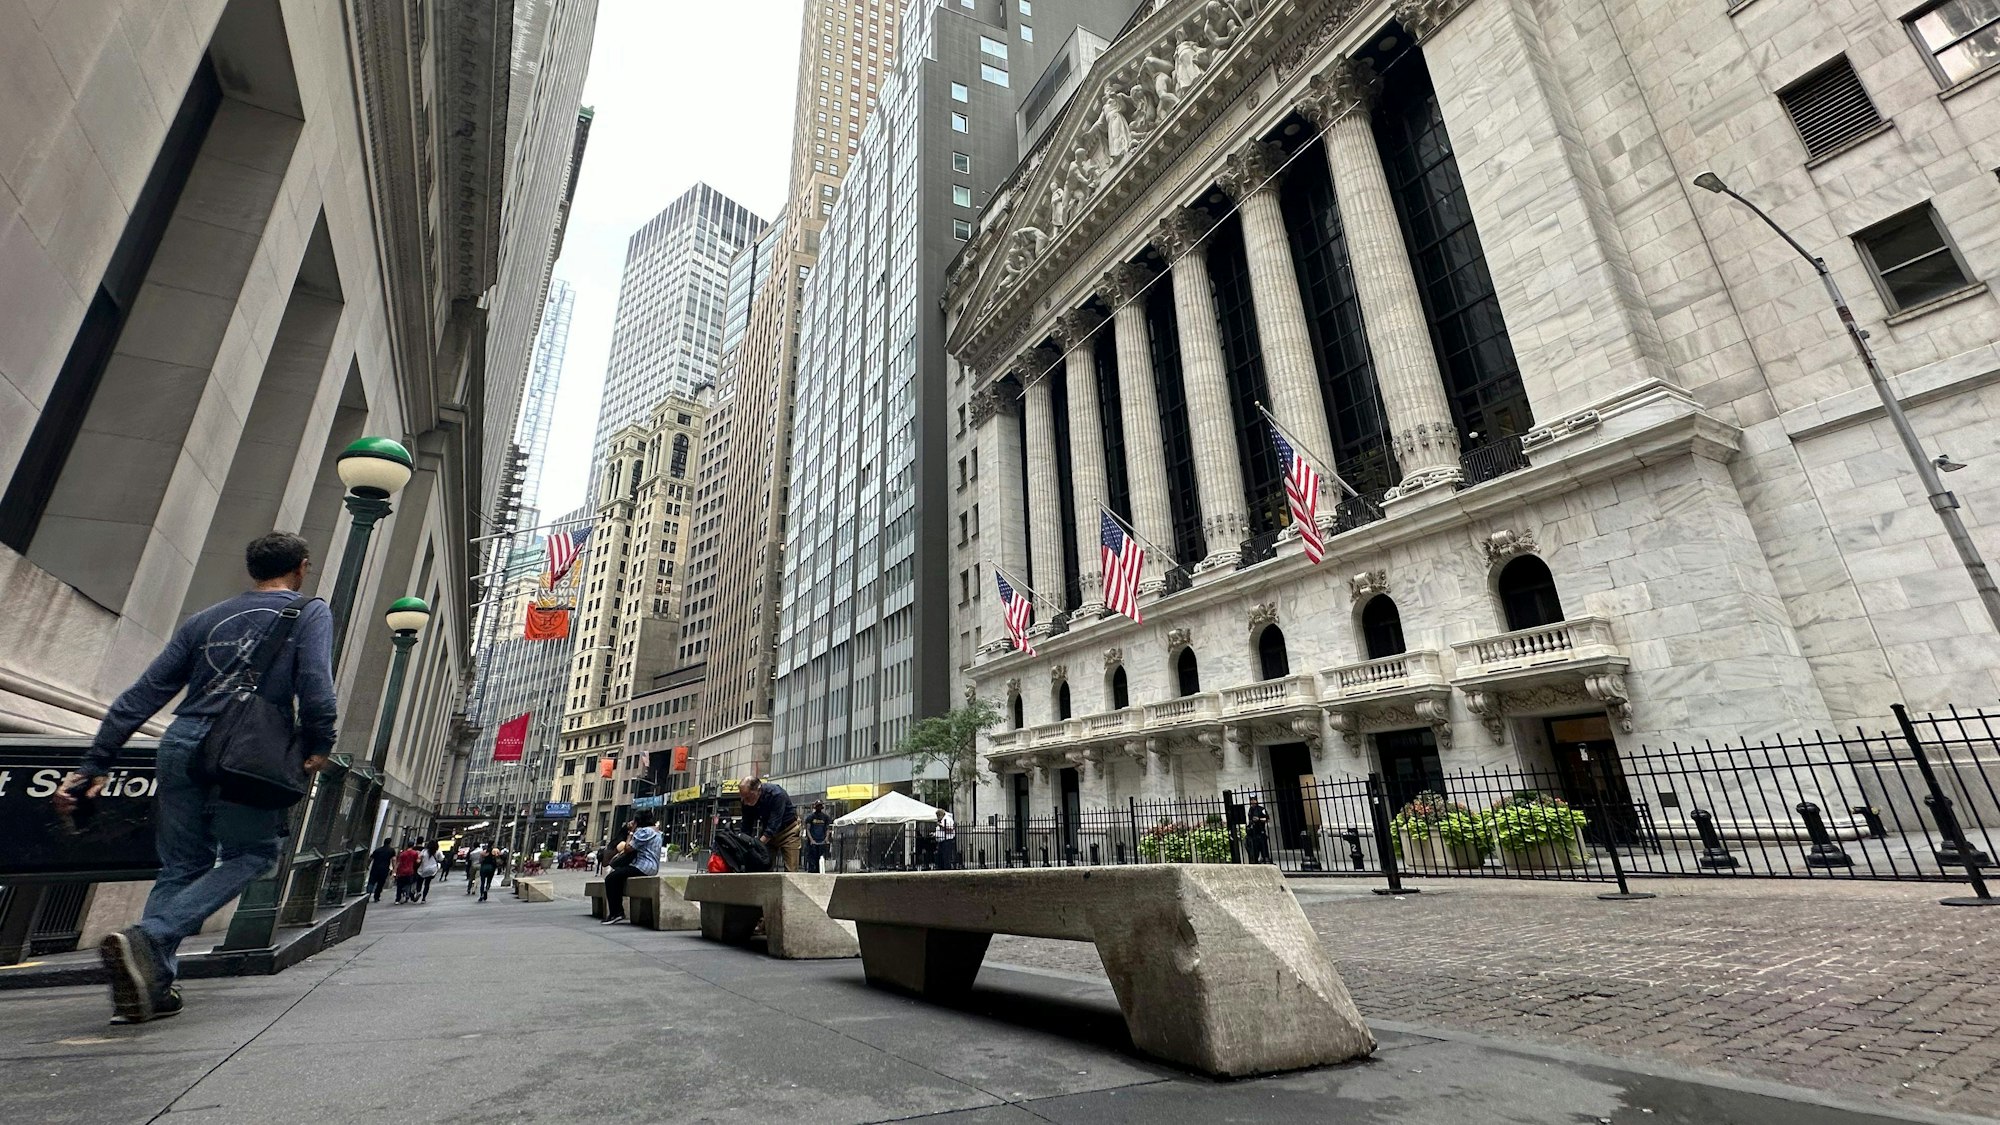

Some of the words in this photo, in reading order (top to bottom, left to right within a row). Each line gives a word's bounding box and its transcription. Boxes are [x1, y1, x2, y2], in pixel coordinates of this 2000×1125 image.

[1160, 116, 1234, 198] EXCHANGE
[27, 769, 158, 798] Stio
[1351, 844, 1357, 852] 2
